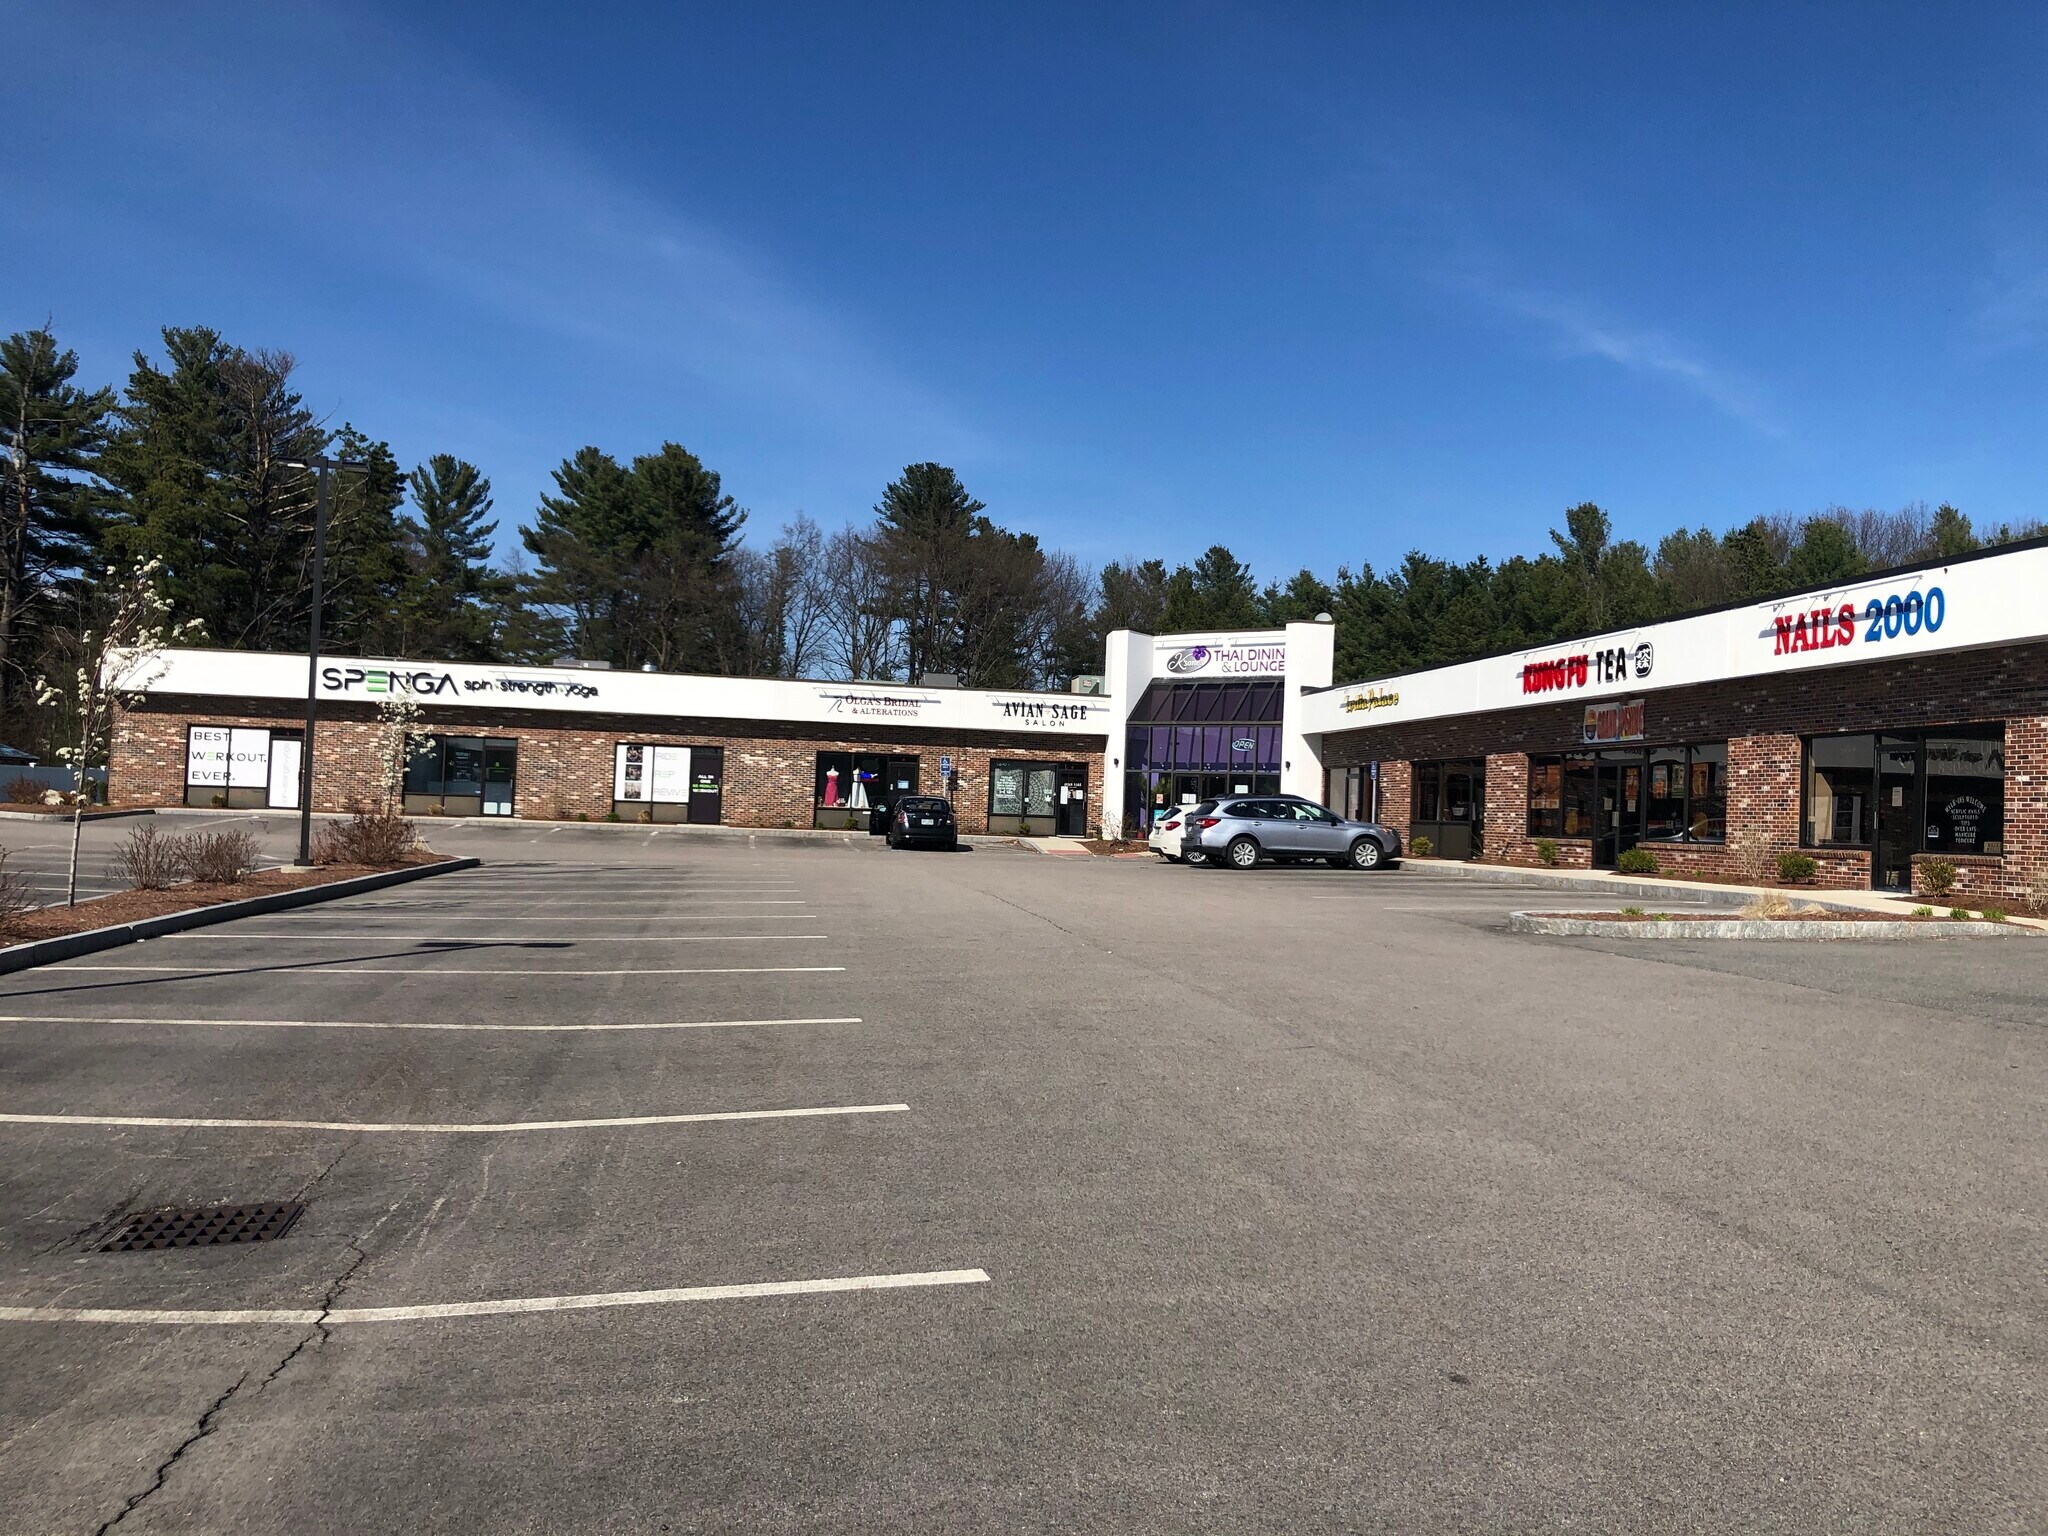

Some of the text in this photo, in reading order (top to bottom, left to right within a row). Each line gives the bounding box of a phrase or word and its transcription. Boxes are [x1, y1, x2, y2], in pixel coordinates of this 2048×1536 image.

[1774, 587, 1945, 656] NAILS 2000
[1214, 647, 1285, 661] THAI DININ
[1221, 660, 1285, 673] & LOUNGE
[1523, 647, 1627, 695] KUNG FU TEA
[322, 668, 460, 696] SPENGA
[464, 678, 599, 699] spin strength yoga
[845, 694, 921, 708] OLGA'S BRIDAL
[851, 707, 919, 717] & ALTERATIONS
[1003, 702, 1088, 721] AVIAN SAGE
[1025, 718, 1065, 727] SALON
[194, 731, 231, 742] BEST
